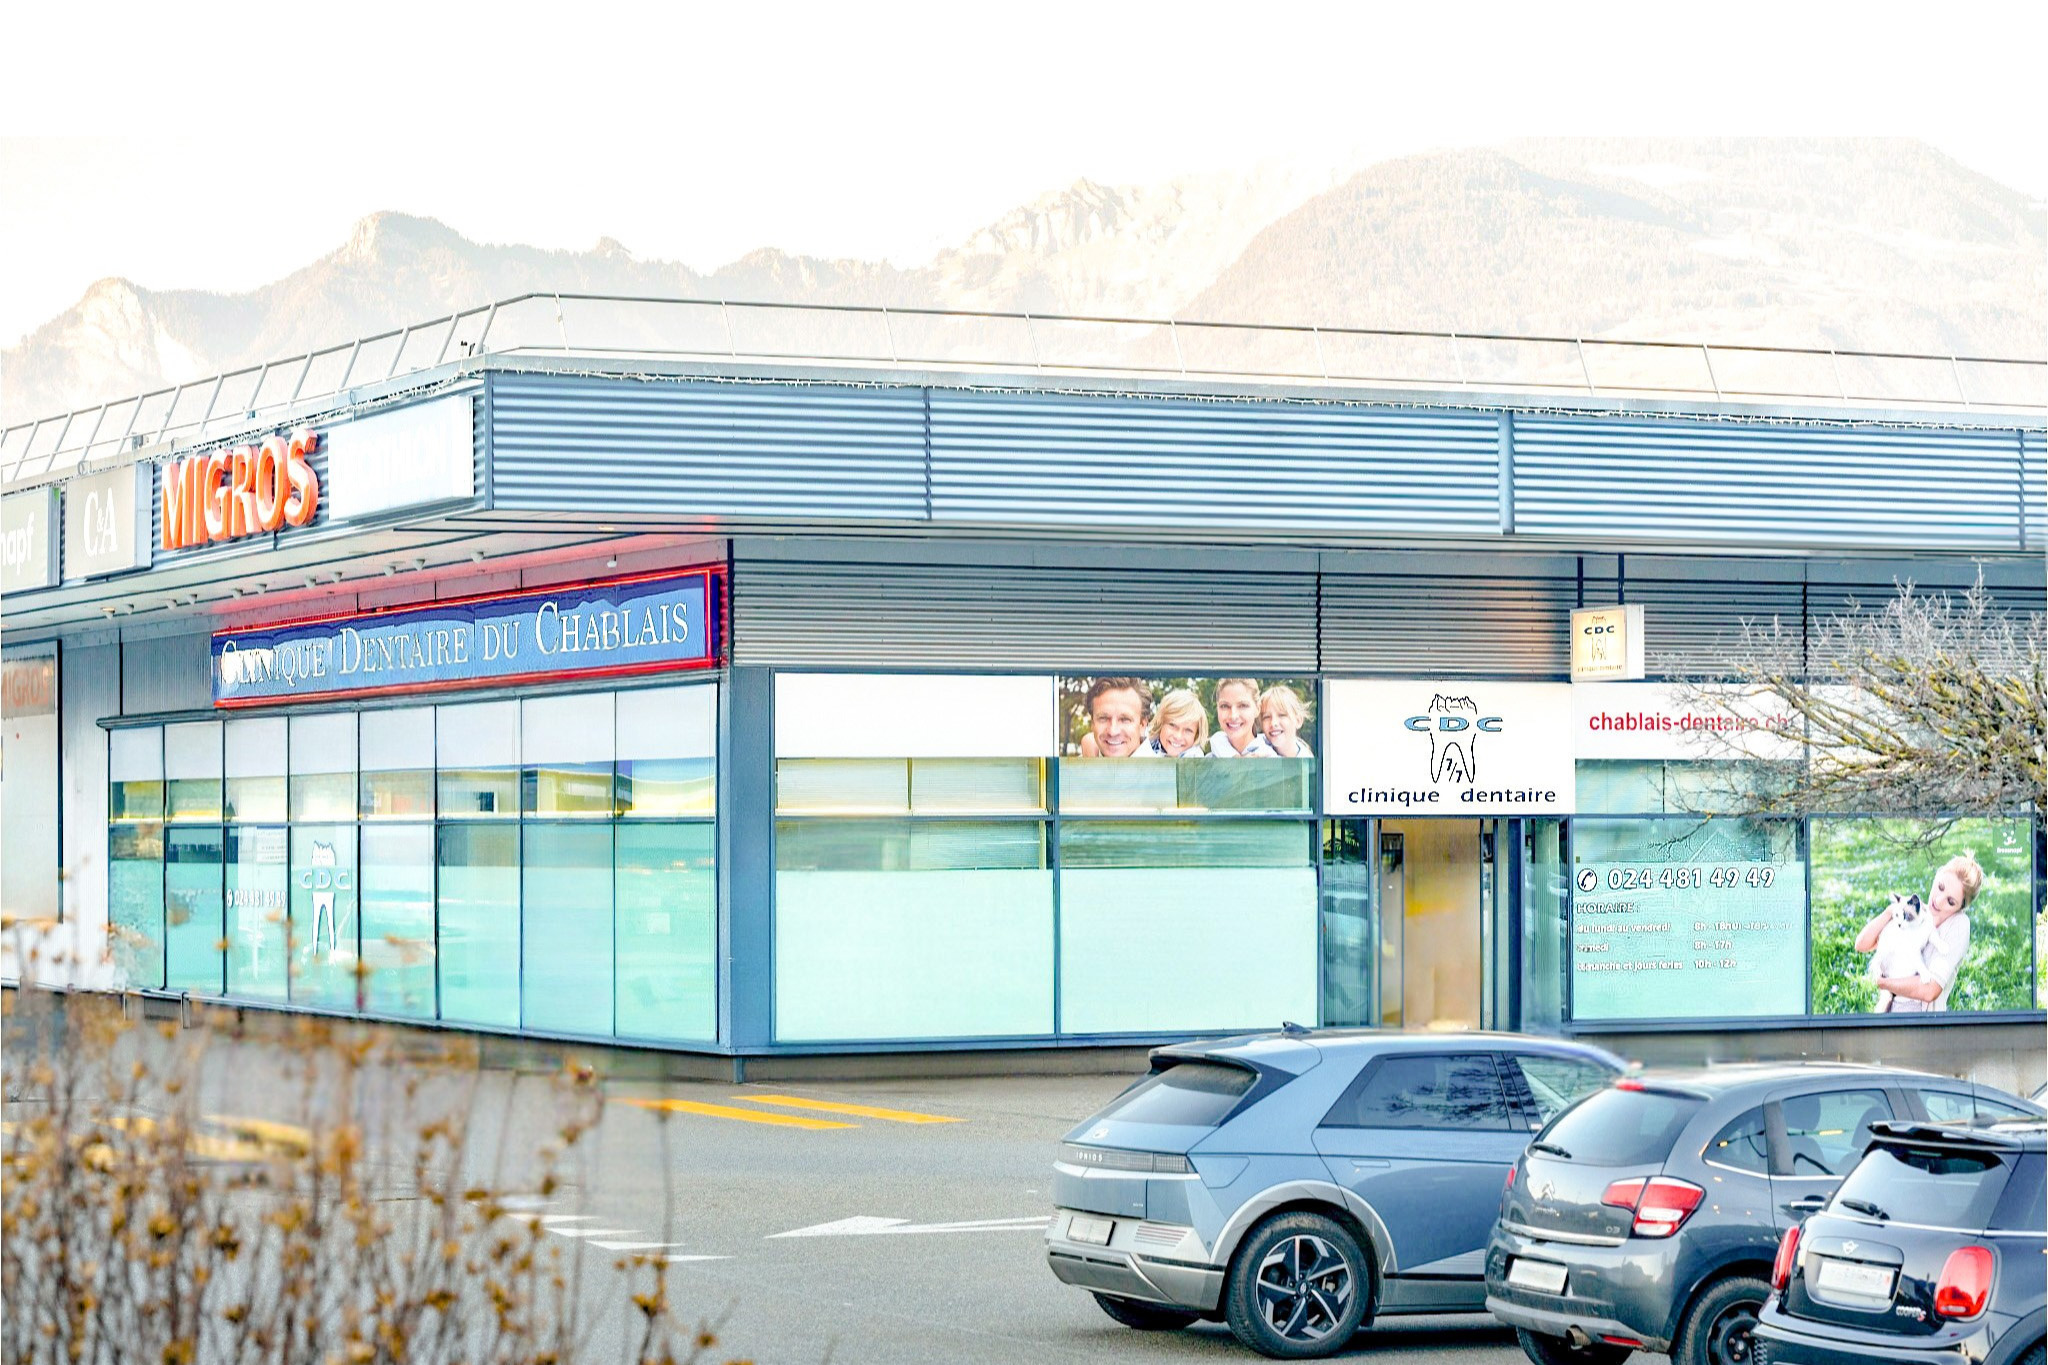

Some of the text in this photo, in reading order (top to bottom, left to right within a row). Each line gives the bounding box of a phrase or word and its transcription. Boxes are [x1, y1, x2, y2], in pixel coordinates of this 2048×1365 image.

[161, 430, 319, 549] MIGROS
[83, 486, 118, 557] C&A
[338, 627, 469, 675] DENTAIRE
[483, 621, 520, 661] DU
[535, 601, 689, 655] CHABLAIS
[1584, 625, 1615, 635] CDC
[1404, 716, 1503, 732] CDC
[1446, 758, 1463, 783] 7/7
[1348, 788, 1556, 807] clinique dentaire
[300, 869, 351, 889] CDC
[1608, 867, 1775, 890] 024 481 49 49
[1577, 902, 1634, 914] HORAIRE
